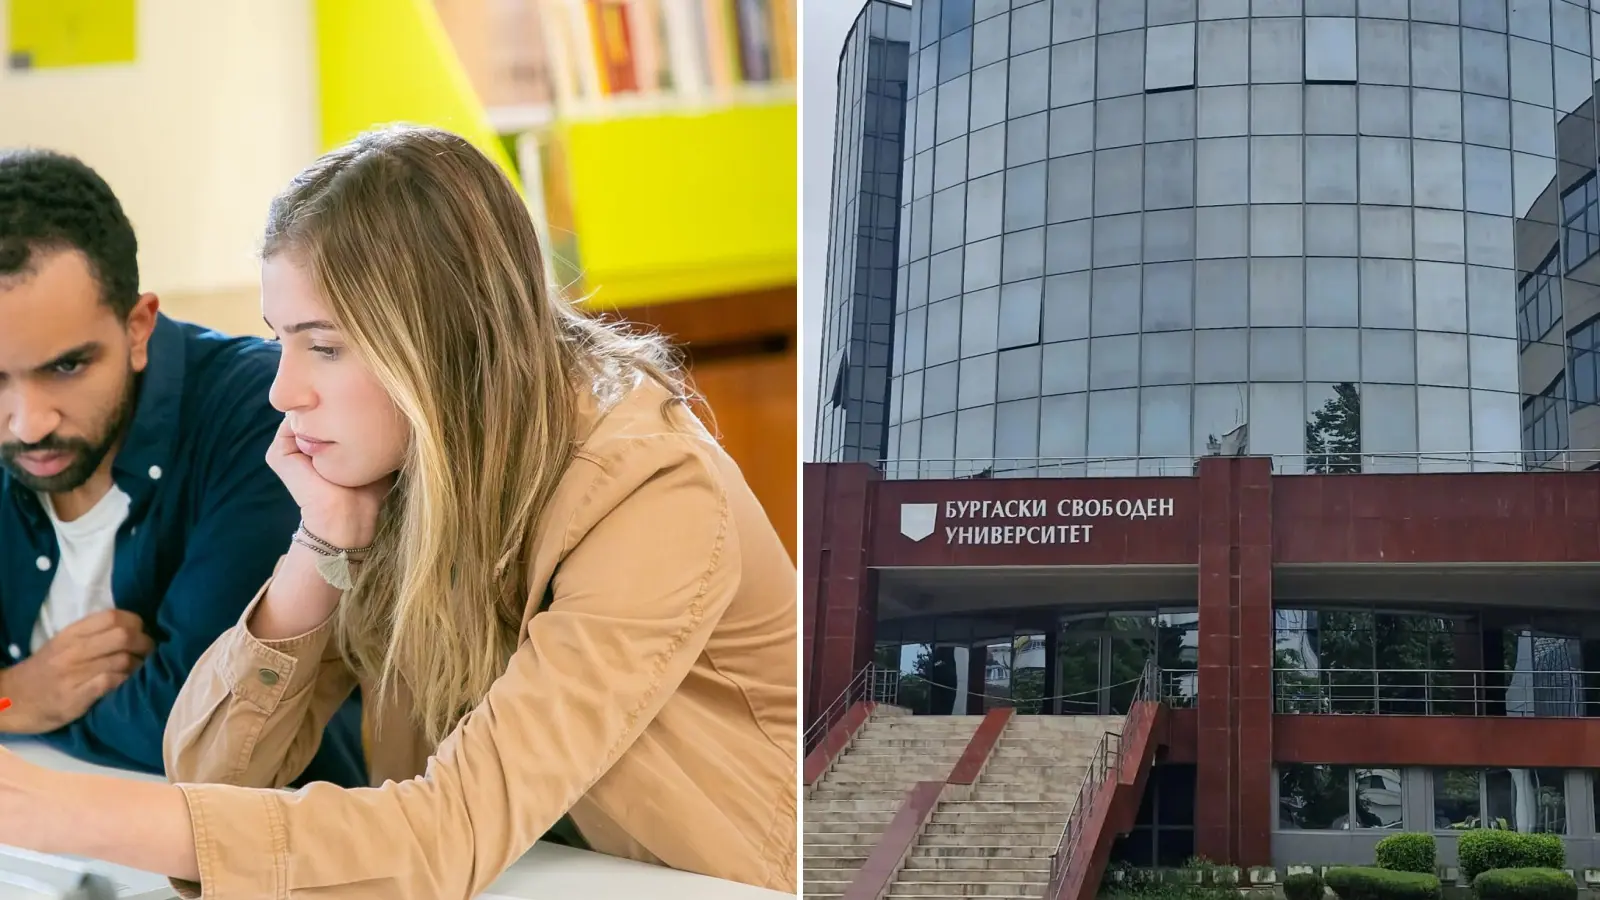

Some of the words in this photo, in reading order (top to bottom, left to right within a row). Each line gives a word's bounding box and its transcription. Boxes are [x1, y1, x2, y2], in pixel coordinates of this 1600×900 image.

[945, 499, 1047, 519] БУРГАСКИ
[1057, 498, 1174, 521] СВОБОДЕН
[945, 524, 1093, 545] УНИВЕРСИТЕТ
